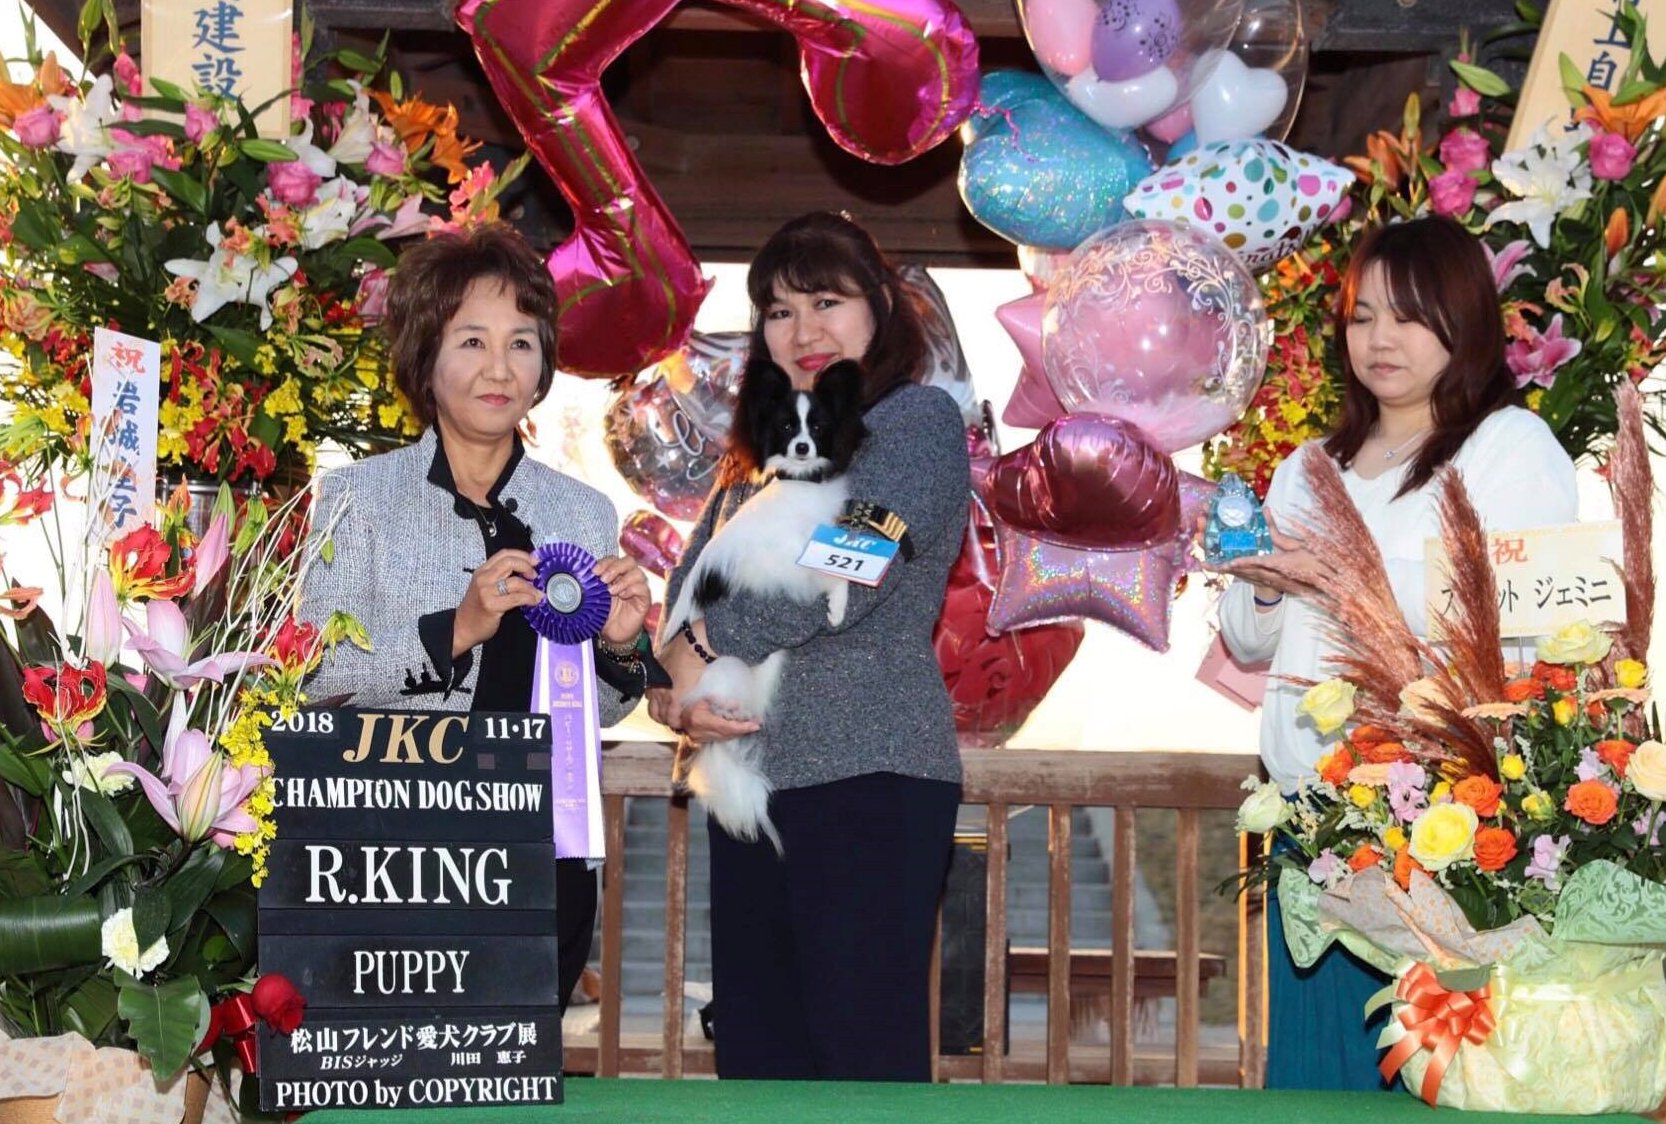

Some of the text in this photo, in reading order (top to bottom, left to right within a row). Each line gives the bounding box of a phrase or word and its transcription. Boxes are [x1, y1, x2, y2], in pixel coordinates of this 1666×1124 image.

[191, 1, 247, 101] 建設
[111, 341, 146, 375] 祝
[824, 554, 866, 572] 521
[1490, 537, 1529, 566] 祝
[1534, 575, 1613, 610] ジェミニ
[270, 711, 334, 734] 2018
[342, 713, 470, 765] JKC
[271, 777, 543, 812] CHAMPION DOG SHOW
[305, 845, 513, 906] R.KING
[353, 950, 470, 995] PUPPY
[290, 1021, 538, 1054] 松山フレンド愛犬クラブ展
[320, 1053, 403, 1070] BISジャッジ
[449, 1052, 481, 1066] 川田
[276, 1076, 558, 1108] PHOTO by COPYRIGHT
